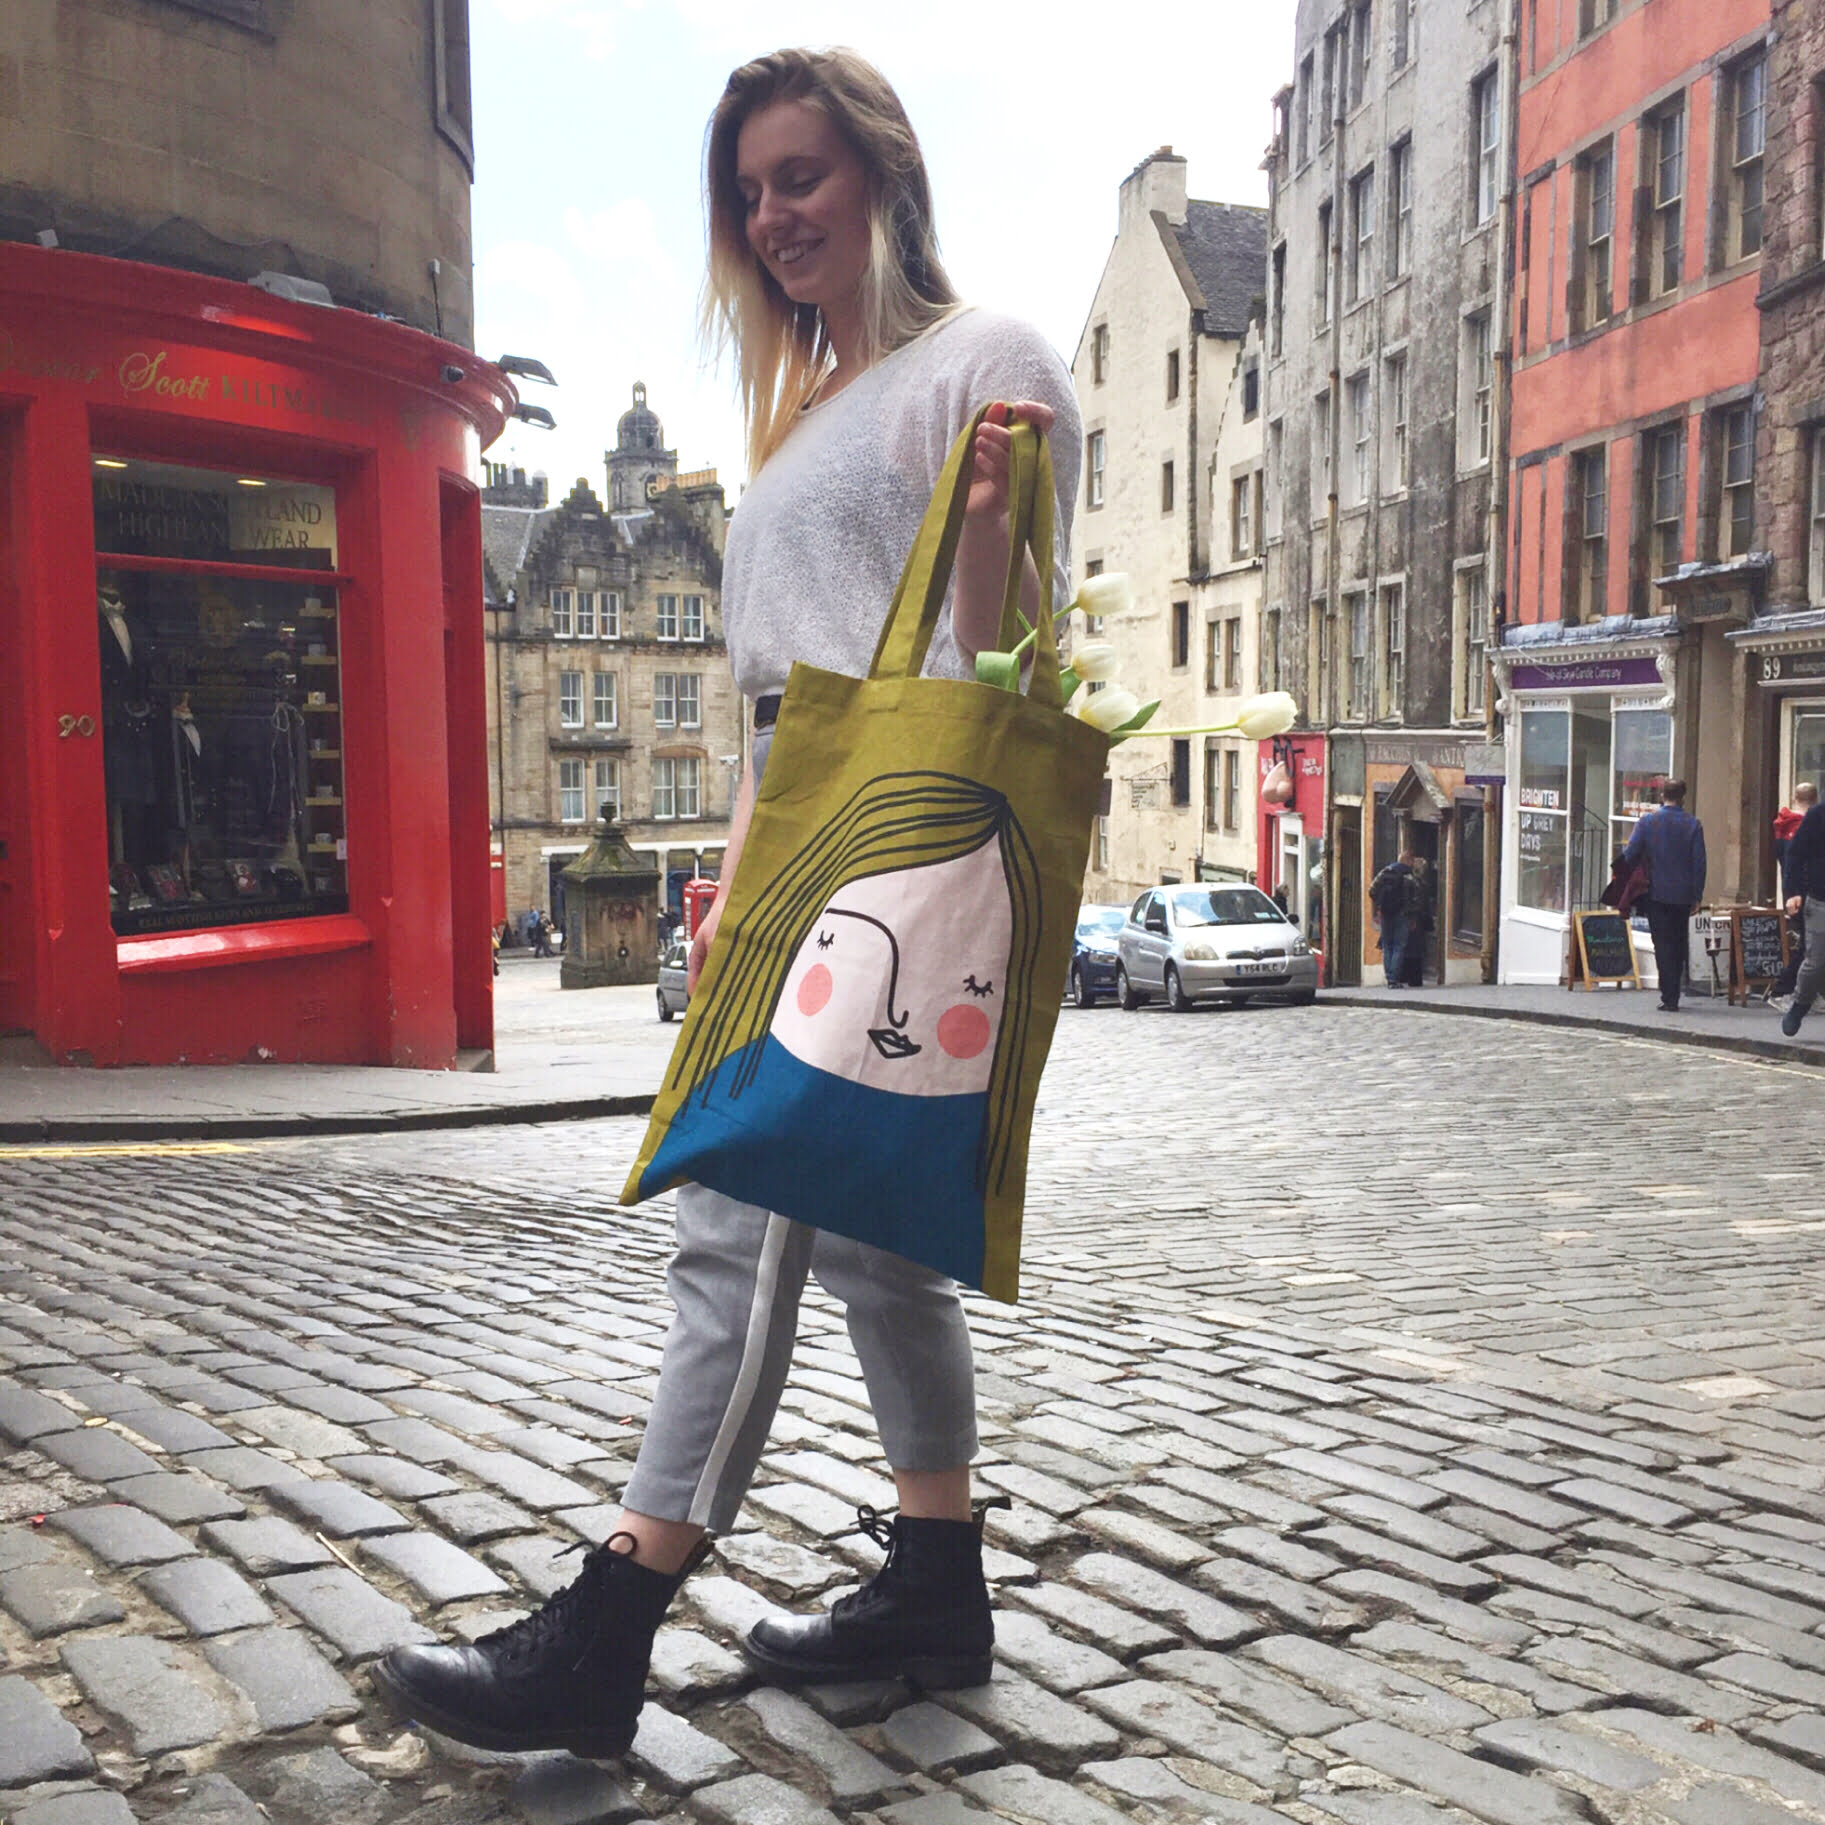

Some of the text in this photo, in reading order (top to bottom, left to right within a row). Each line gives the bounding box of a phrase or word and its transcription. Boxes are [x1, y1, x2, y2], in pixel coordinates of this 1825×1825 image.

[119, 351, 209, 399] Scott
[1763, 657, 1780, 679] 89
[57, 714, 96, 738] 90
[1520, 787, 1560, 808] BRIGHTEN
[1521, 813, 1531, 830] UP
[1521, 832, 1541, 852] DAYS
